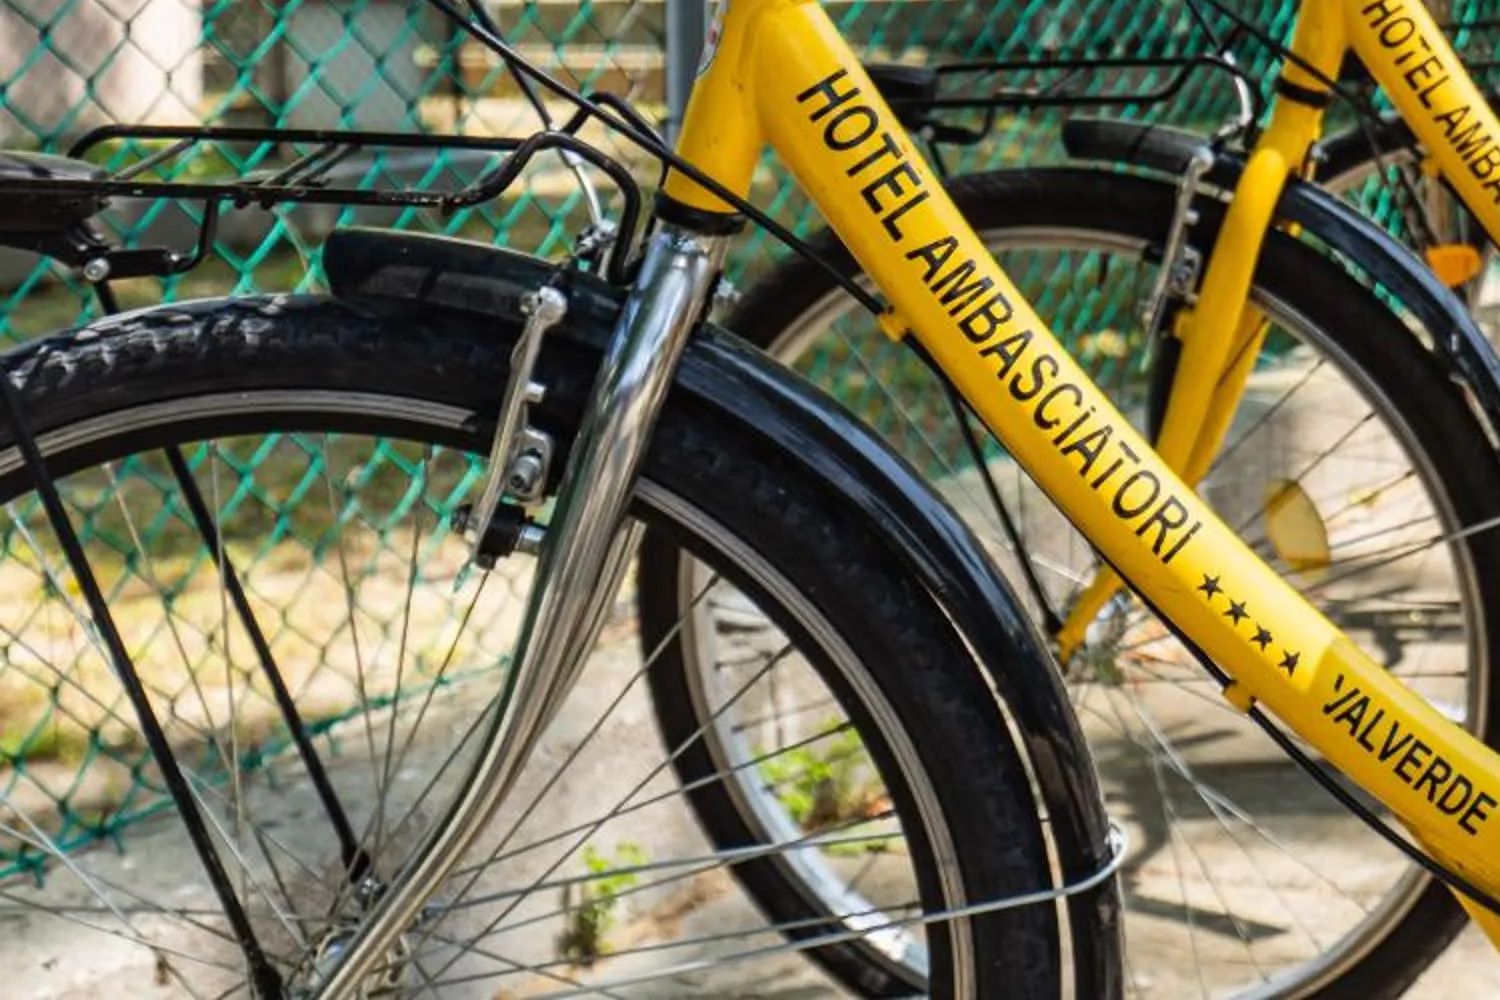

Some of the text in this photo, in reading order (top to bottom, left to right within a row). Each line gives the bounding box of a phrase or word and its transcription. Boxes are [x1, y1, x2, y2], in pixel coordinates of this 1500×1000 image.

[796, 69, 1498, 836] HOTEL AMBASCIATORI VALVERDE
